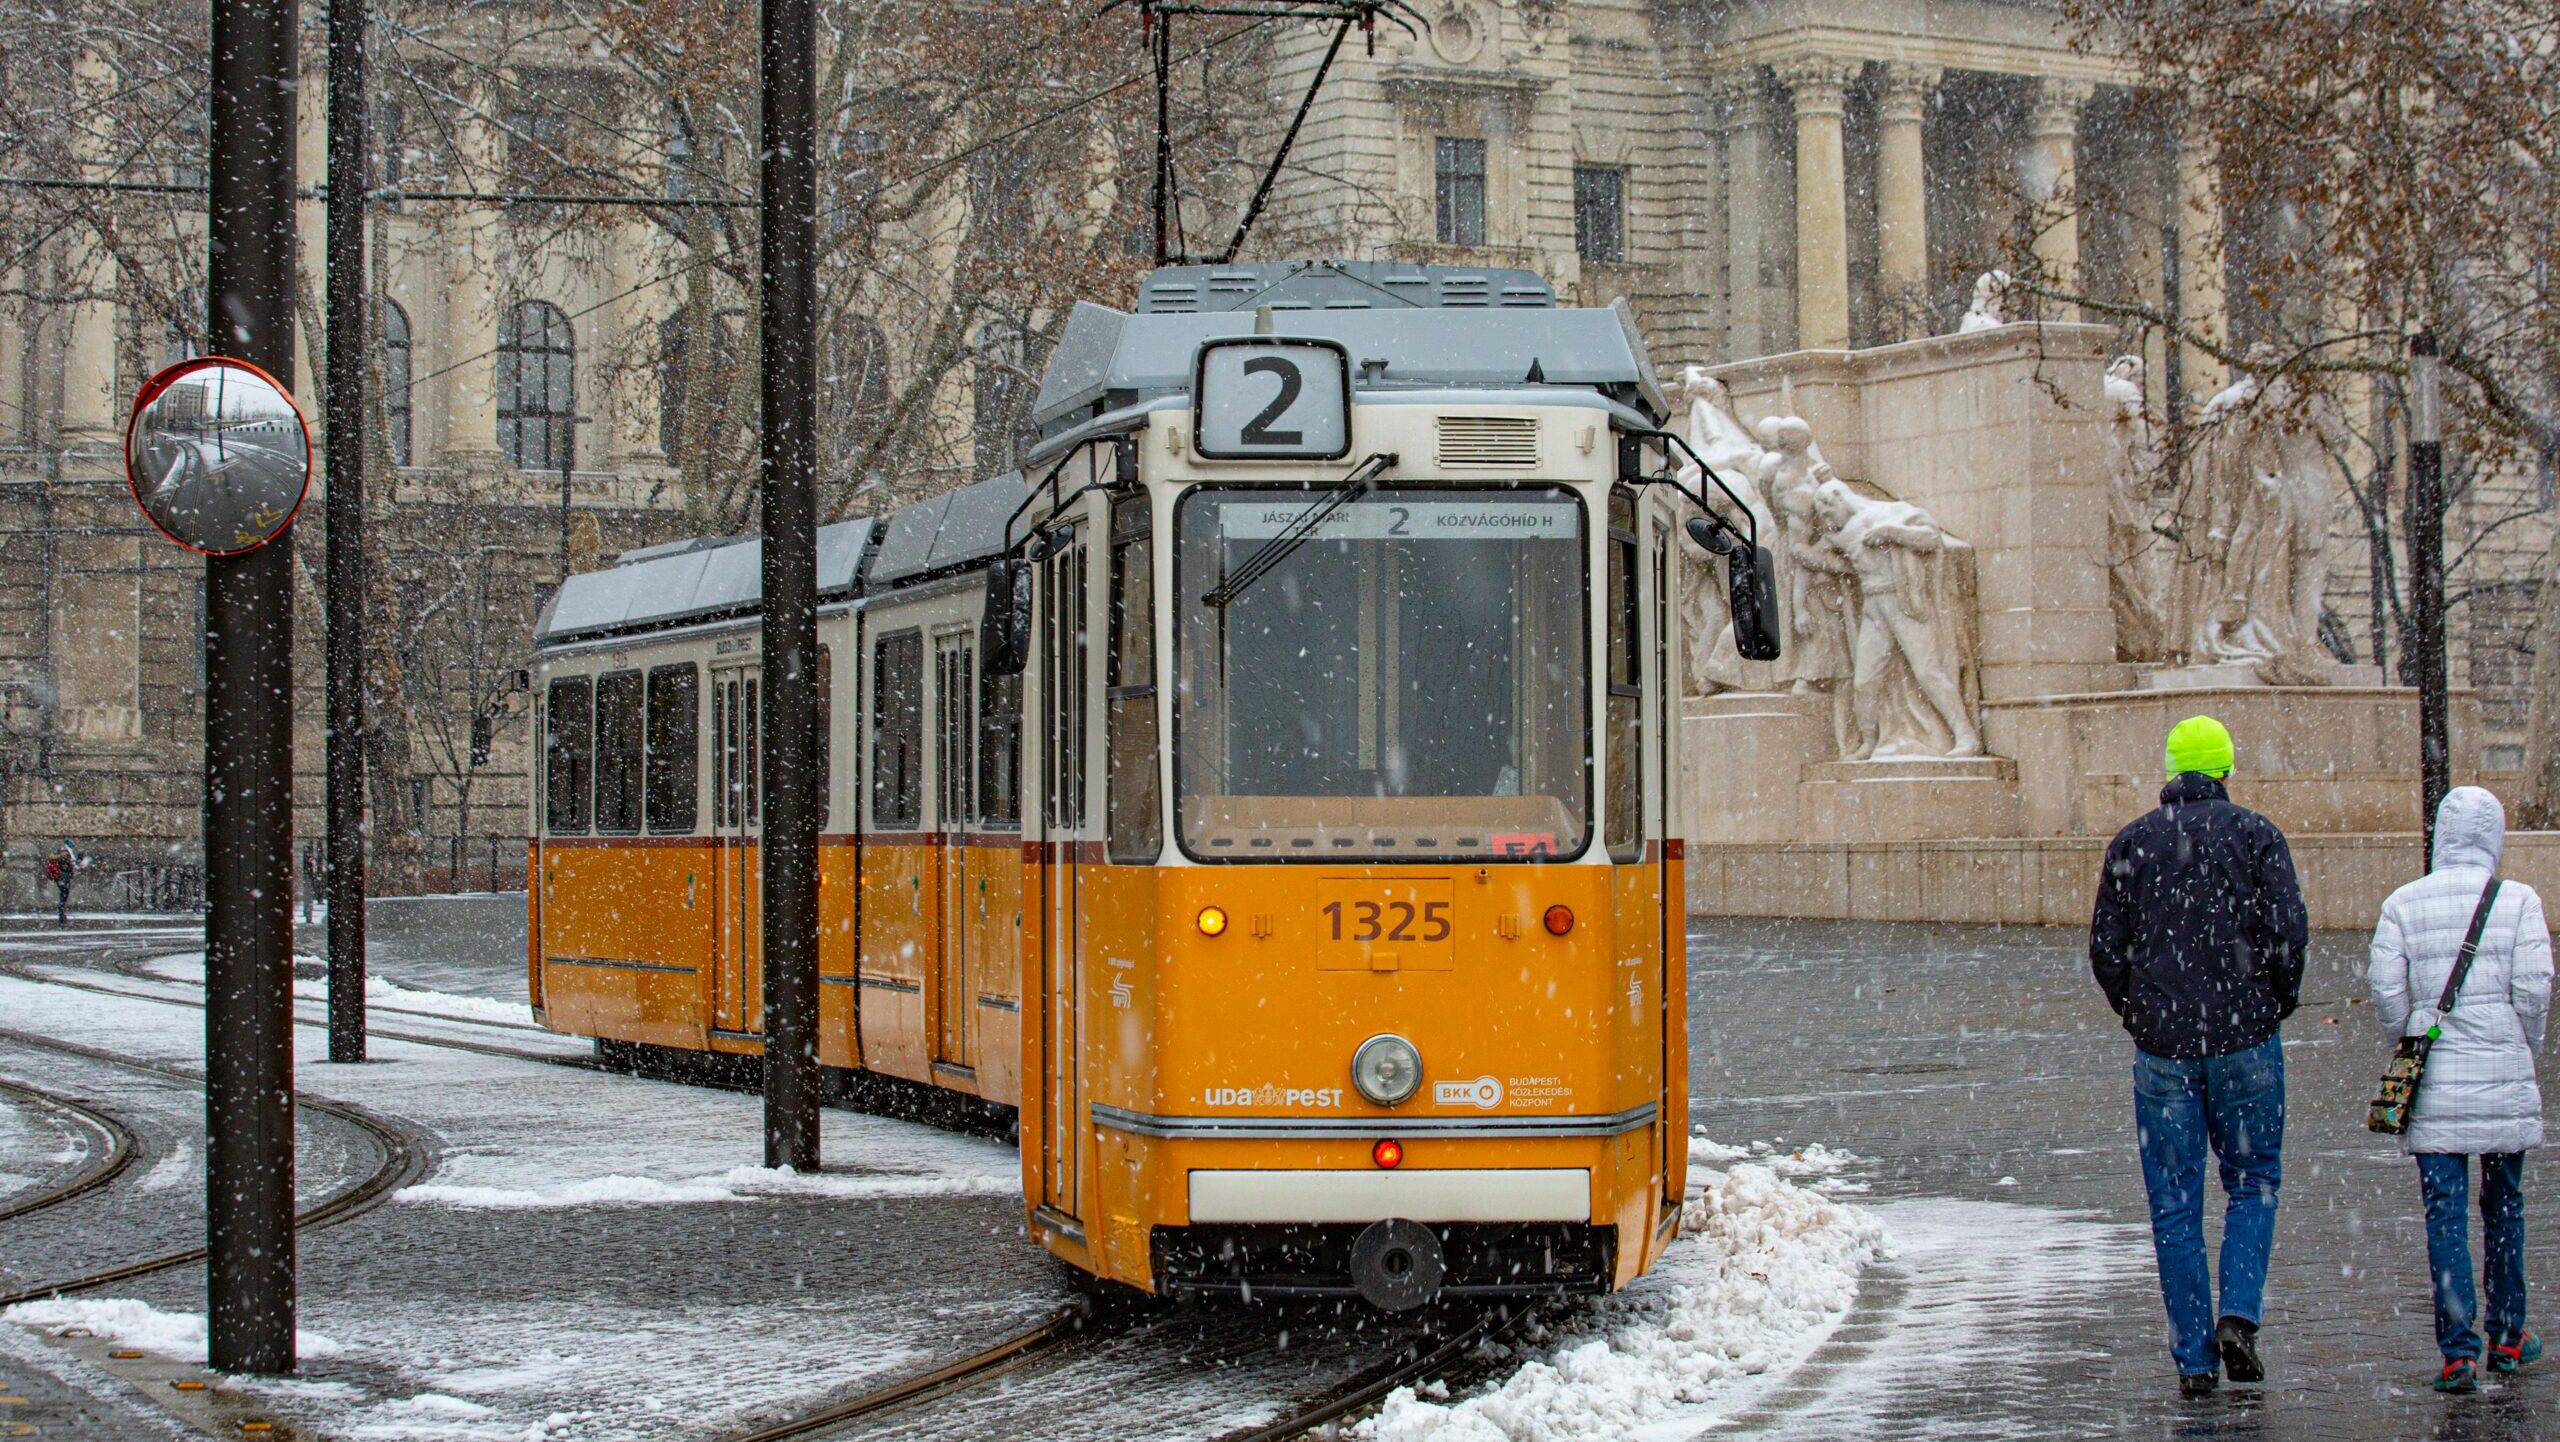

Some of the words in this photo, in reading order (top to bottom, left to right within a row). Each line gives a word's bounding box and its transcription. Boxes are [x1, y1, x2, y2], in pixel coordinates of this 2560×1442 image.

[1241, 357, 1303, 445] 2
[1388, 507, 1410, 536] 2
[1437, 513, 1537, 527] KÖZVÁGÓHÍD
[1543, 516, 1553, 526] H
[1322, 901, 1451, 941] 1325
[1509, 1077, 1561, 1086] BUDAPESTI
[1442, 1088, 1471, 1098] BKK
[1509, 1087, 1573, 1096] KÖZLEKEDÉSI
[1509, 1098, 1553, 1107] KÖZPONT
